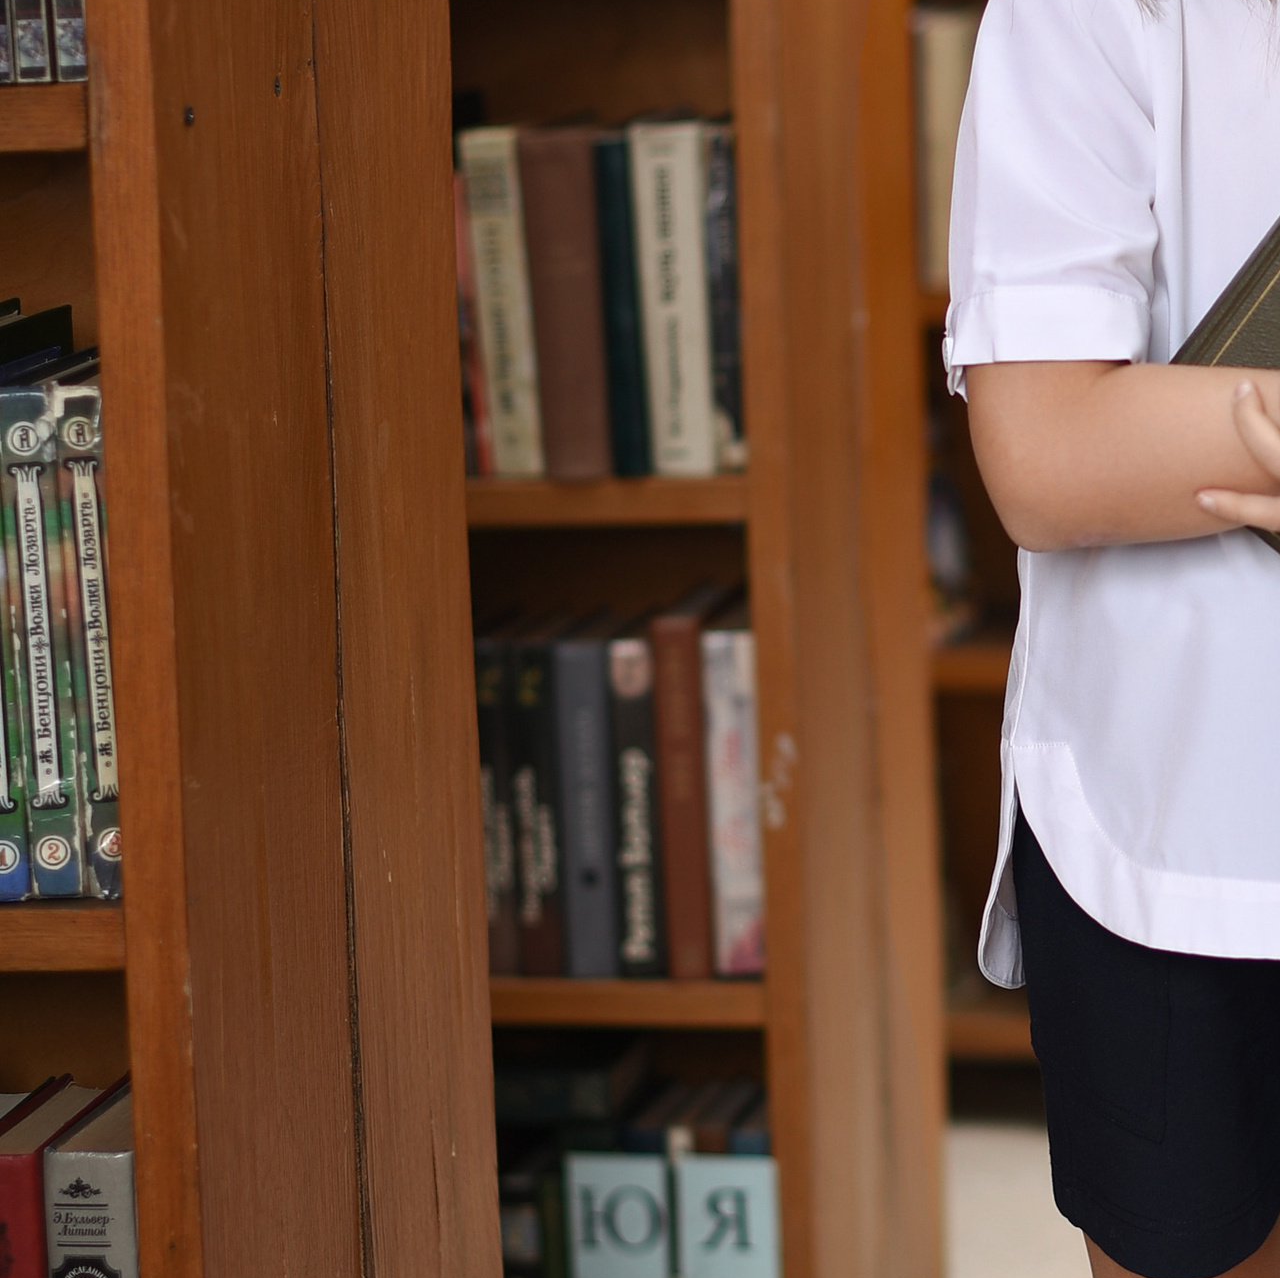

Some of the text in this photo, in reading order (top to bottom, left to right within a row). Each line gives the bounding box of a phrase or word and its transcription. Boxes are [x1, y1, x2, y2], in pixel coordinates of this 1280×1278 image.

[29, 584, 45, 637] Волки
[87, 578, 104, 630] Волки
[32, 655, 52, 740] Бенцони
[94, 649, 111, 732] Бенцони
[47, 843, 61, 861] 2
[58, 1225, 107, 1236] Литтон
[577, 1184, 663, 1254] Ю
[702, 1186, 751, 1253] Я
